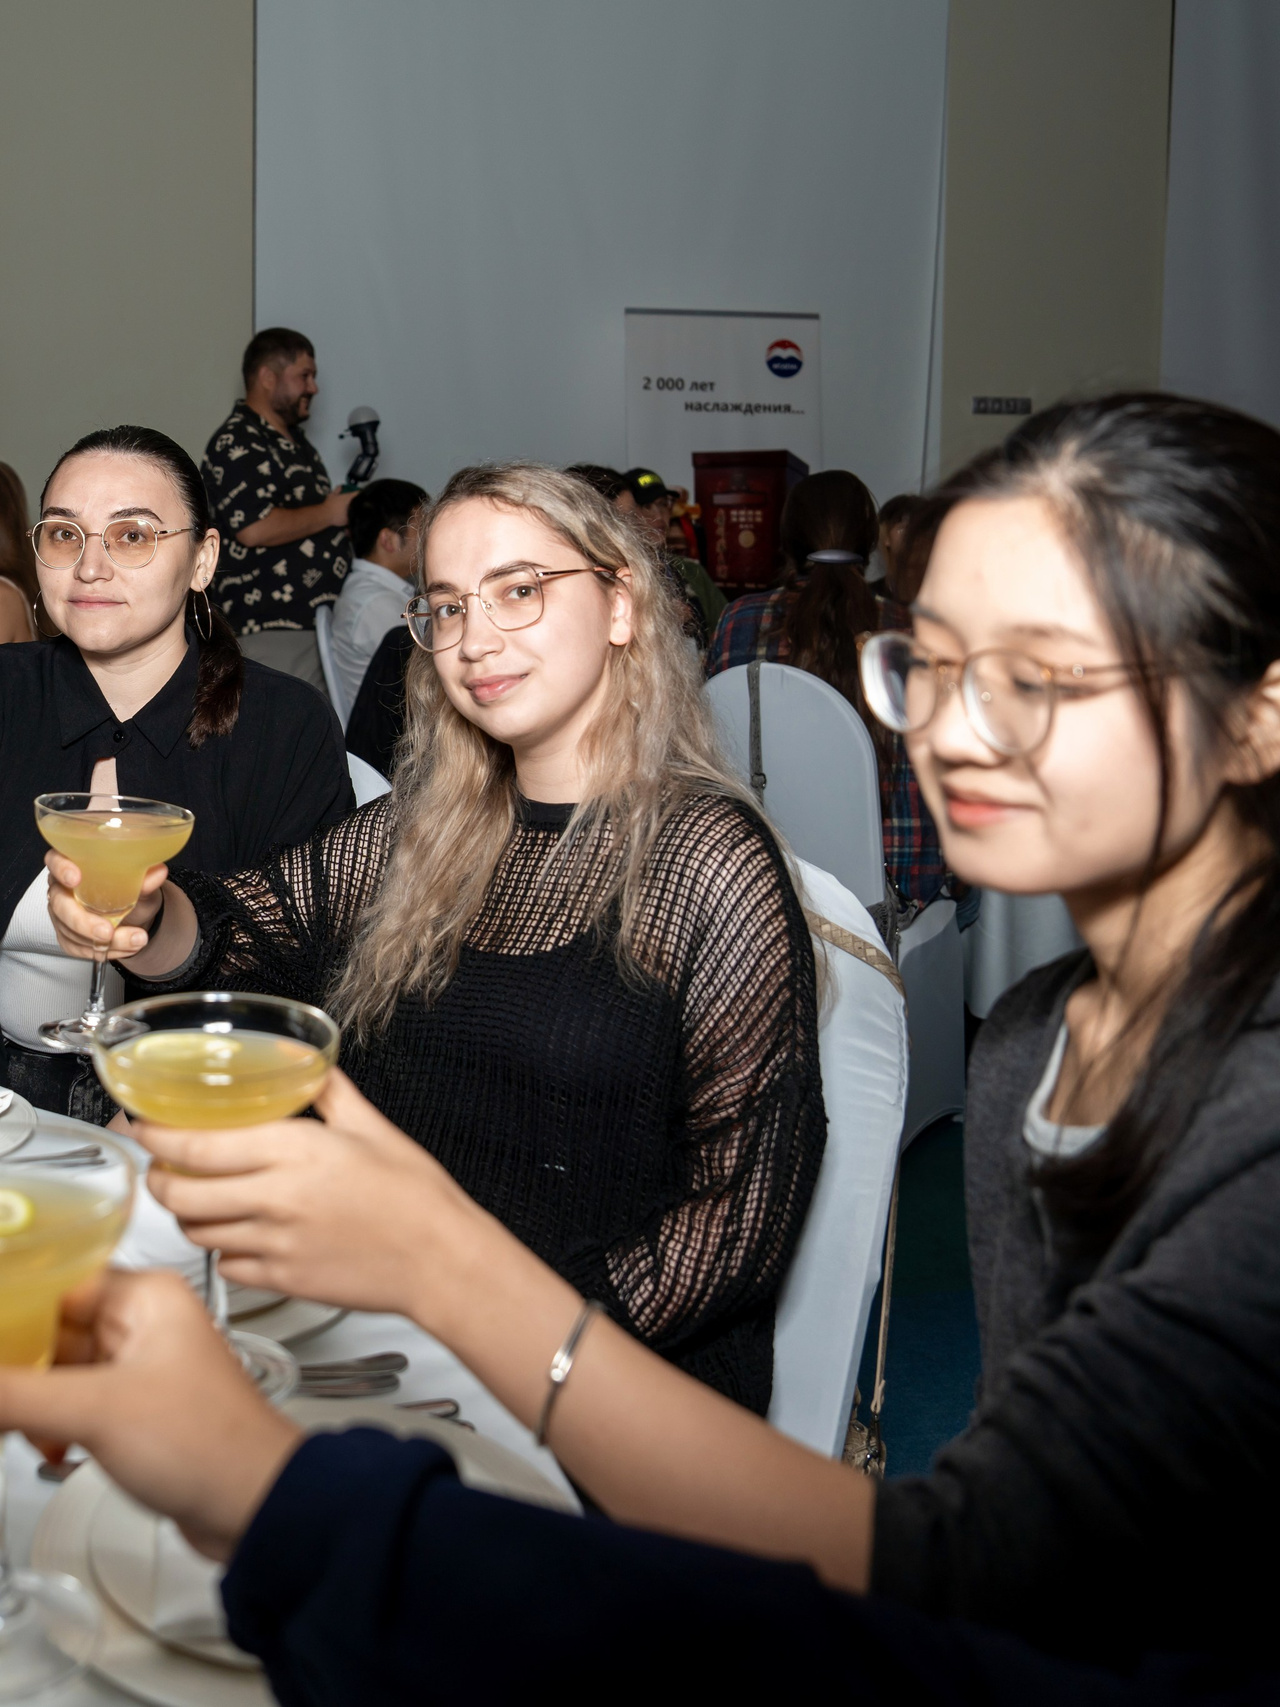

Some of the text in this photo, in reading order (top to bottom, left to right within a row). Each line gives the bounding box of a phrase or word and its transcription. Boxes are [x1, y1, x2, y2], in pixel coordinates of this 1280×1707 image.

[642, 376, 716, 392] 2 000 лет
[684, 401, 805, 416] наслаждения...
